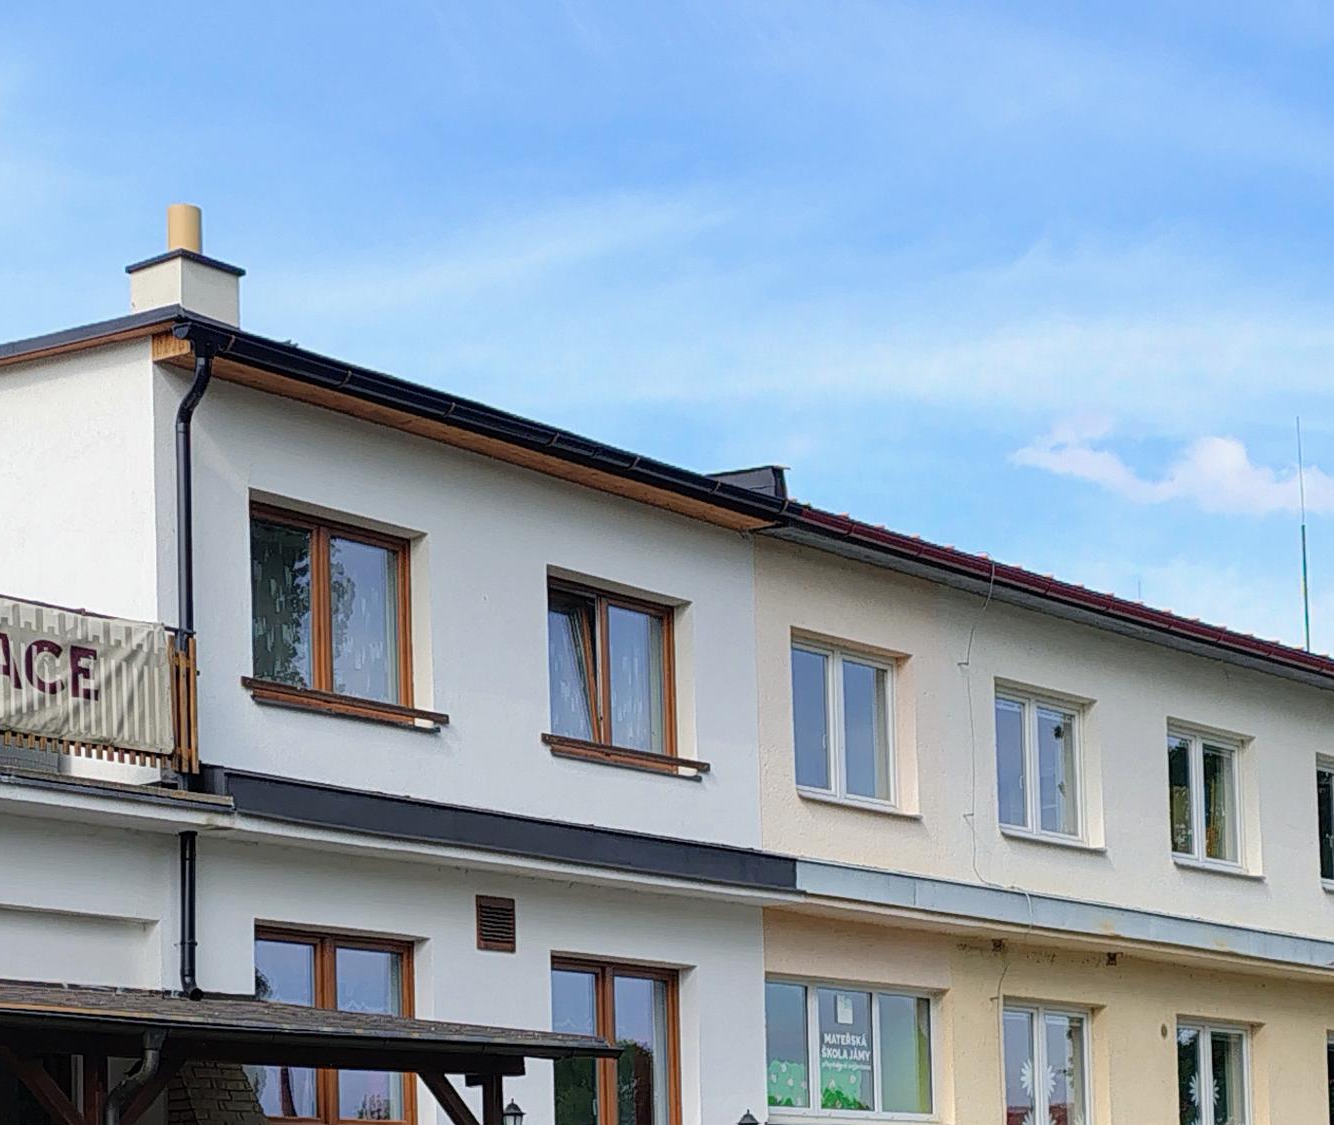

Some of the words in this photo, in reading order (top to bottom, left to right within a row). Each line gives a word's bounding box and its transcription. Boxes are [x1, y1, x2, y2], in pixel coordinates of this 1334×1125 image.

[823, 1032, 868, 1048] MATEŘSKÁ
[821, 1044, 848, 1060] ŠKOLA
[849, 1047, 872, 1062] JÁMY
